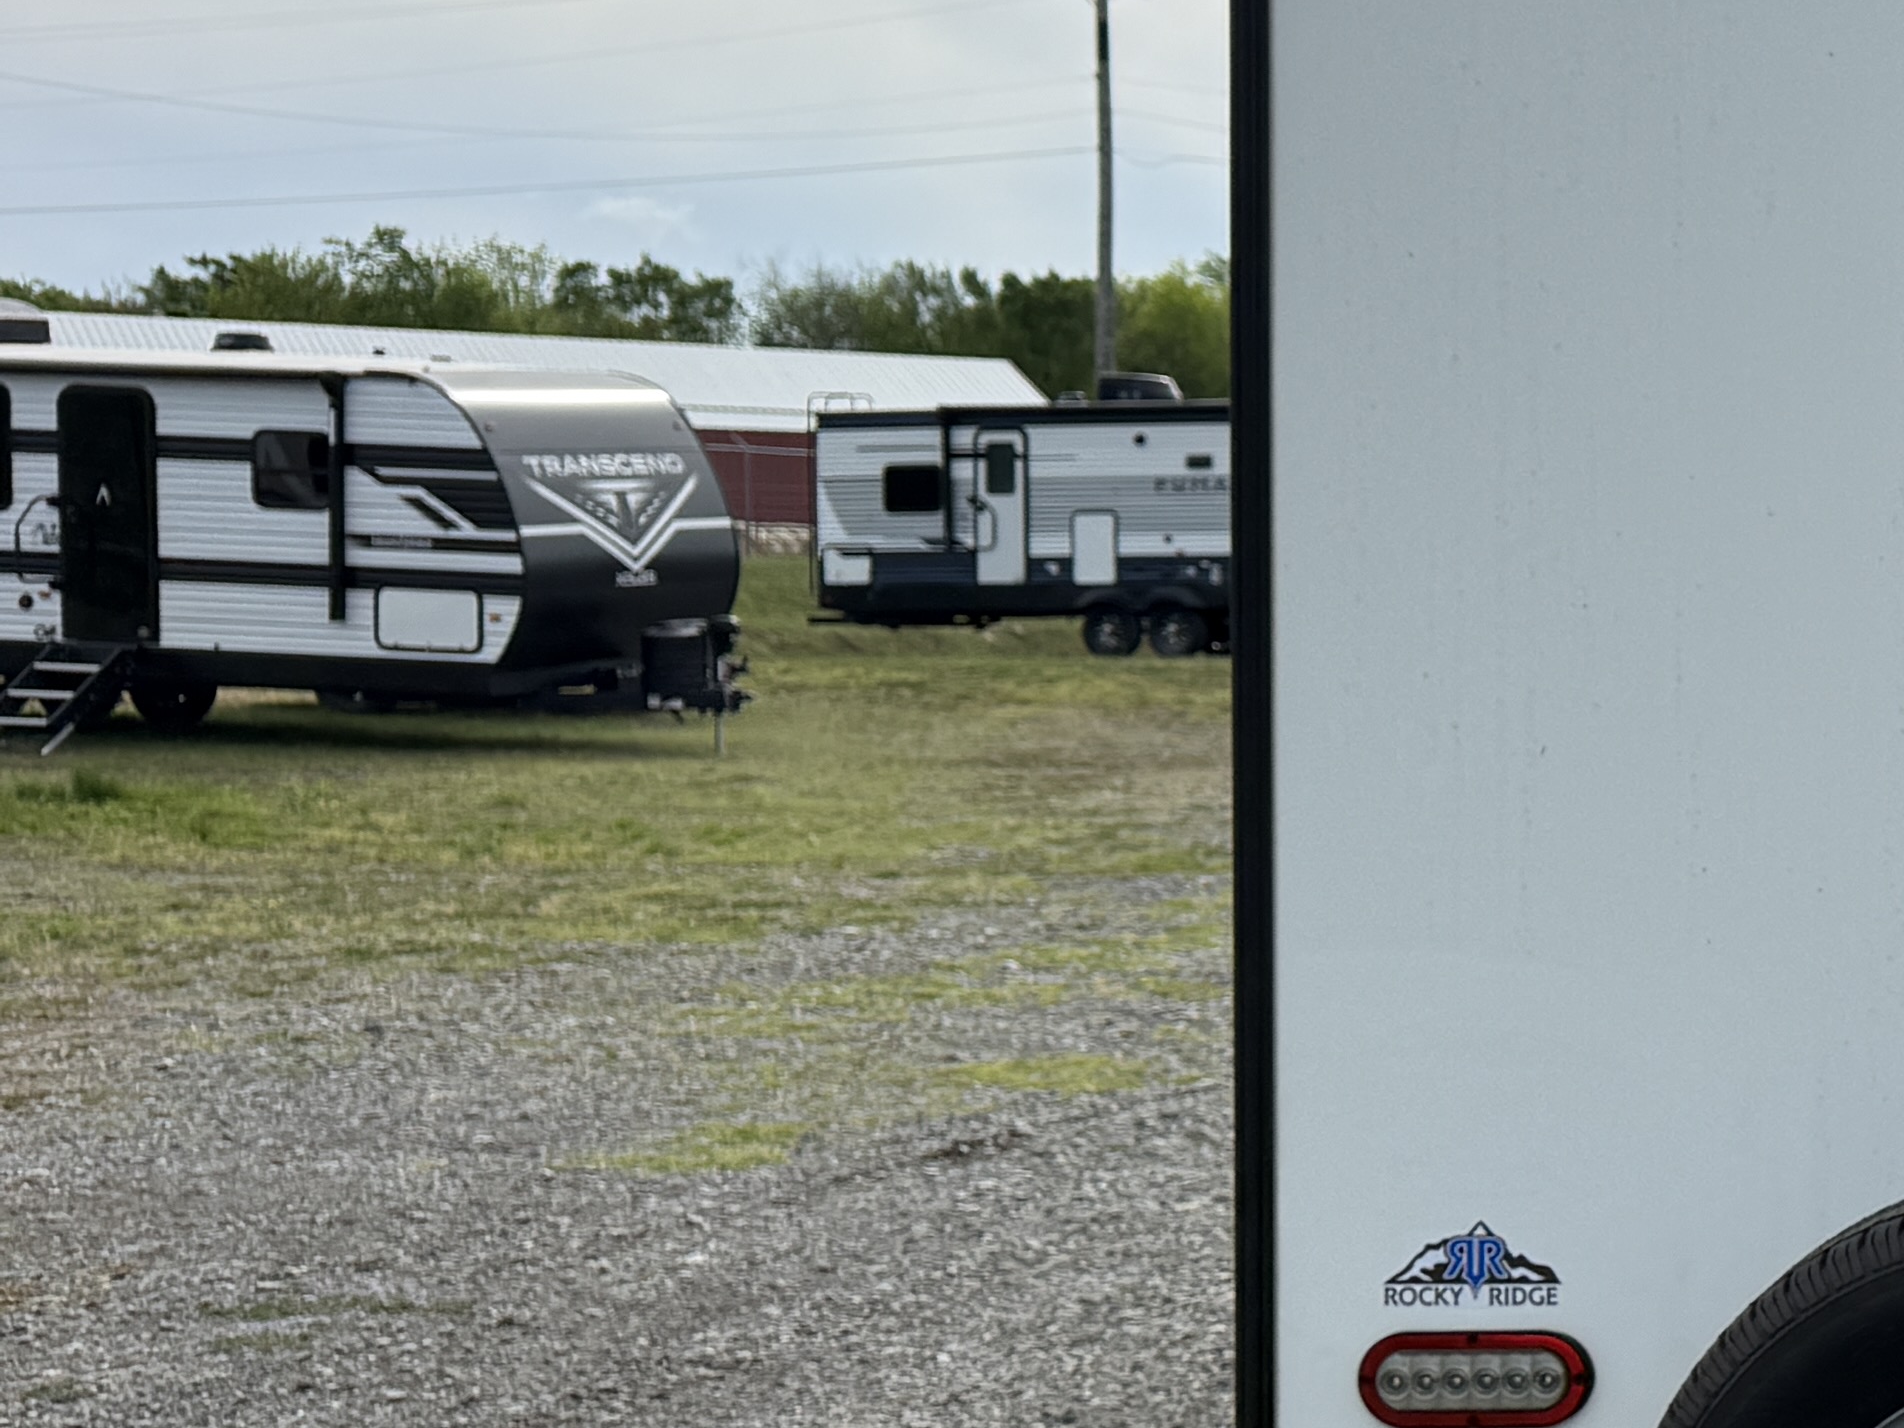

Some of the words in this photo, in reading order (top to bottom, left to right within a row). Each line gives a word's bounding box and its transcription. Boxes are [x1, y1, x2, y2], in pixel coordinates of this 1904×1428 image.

[522, 453, 684, 477] TRANSCEND
[1384, 1286, 1464, 1307] ROCKY
[1488, 1286, 1558, 1307] RIDGE
